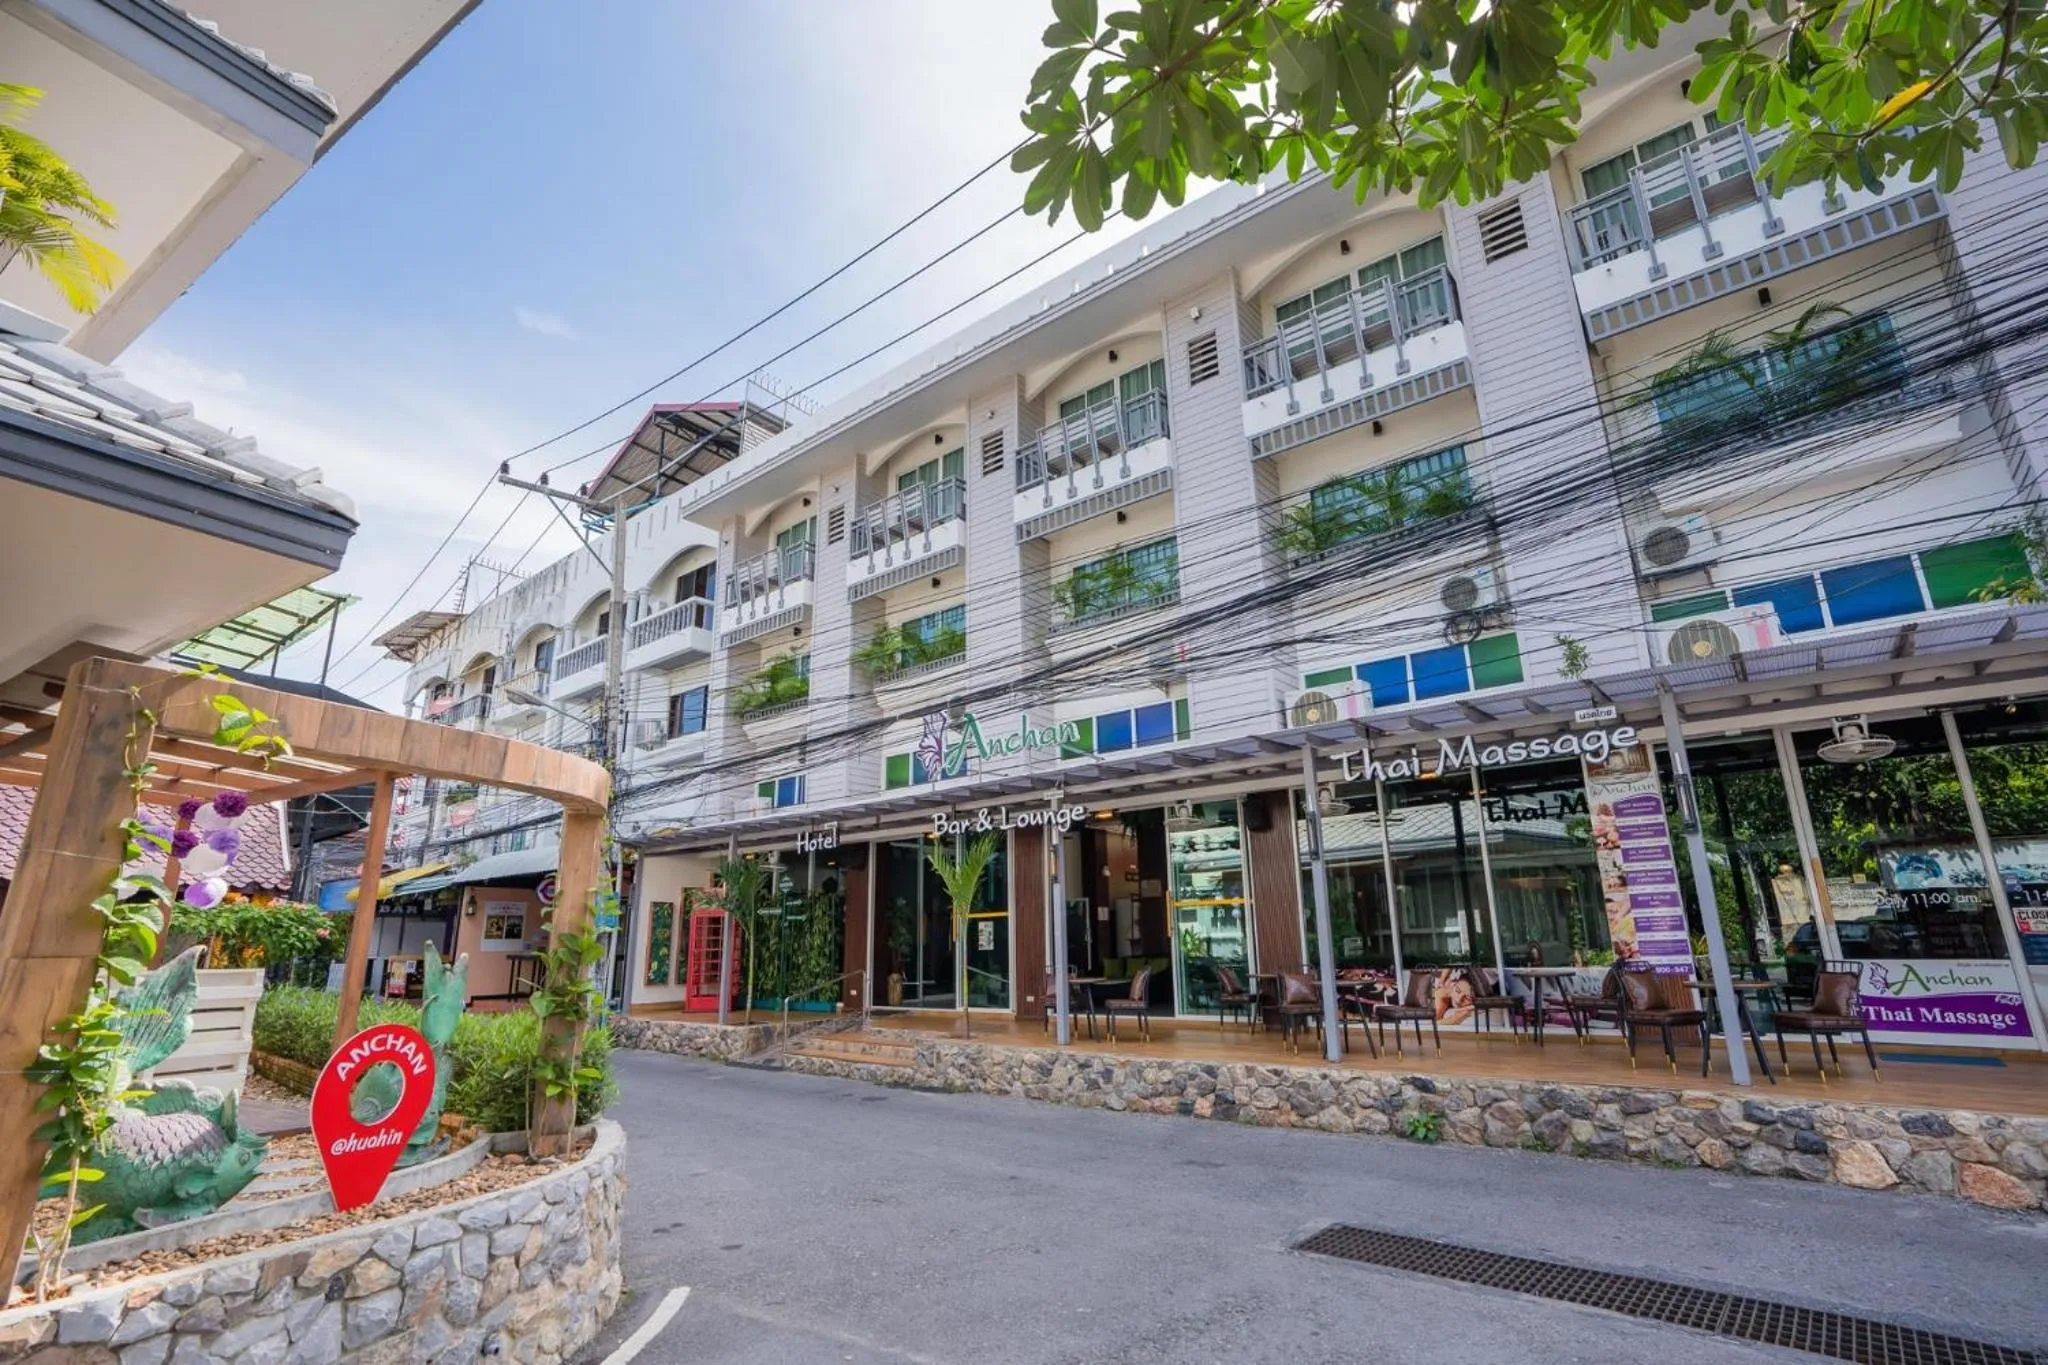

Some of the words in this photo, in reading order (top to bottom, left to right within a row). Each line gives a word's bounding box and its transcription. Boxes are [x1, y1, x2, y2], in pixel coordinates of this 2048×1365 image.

[944, 711, 1081, 776] Anchan
[1330, 748, 1422, 782] Thai
[1436, 726, 1640, 776] Massage
[931, 812, 972, 837] Bar
[975, 807, 997, 833] &
[999, 804, 1087, 833] Lounge
[796, 827, 838, 854] Hotel
[1875, 891, 1909, 909] Daily
[1912, 891, 1950, 908] 11:00
[2017, 910, 2048, 921] CLOS
[1888, 963, 1993, 996] Anchan
[1863, 1004, 1913, 1023] Thai
[1919, 1007, 2017, 1030] Massage
[336, 1033, 427, 1082] ANCHAN
[330, 1128, 403, 1156] @huahin
